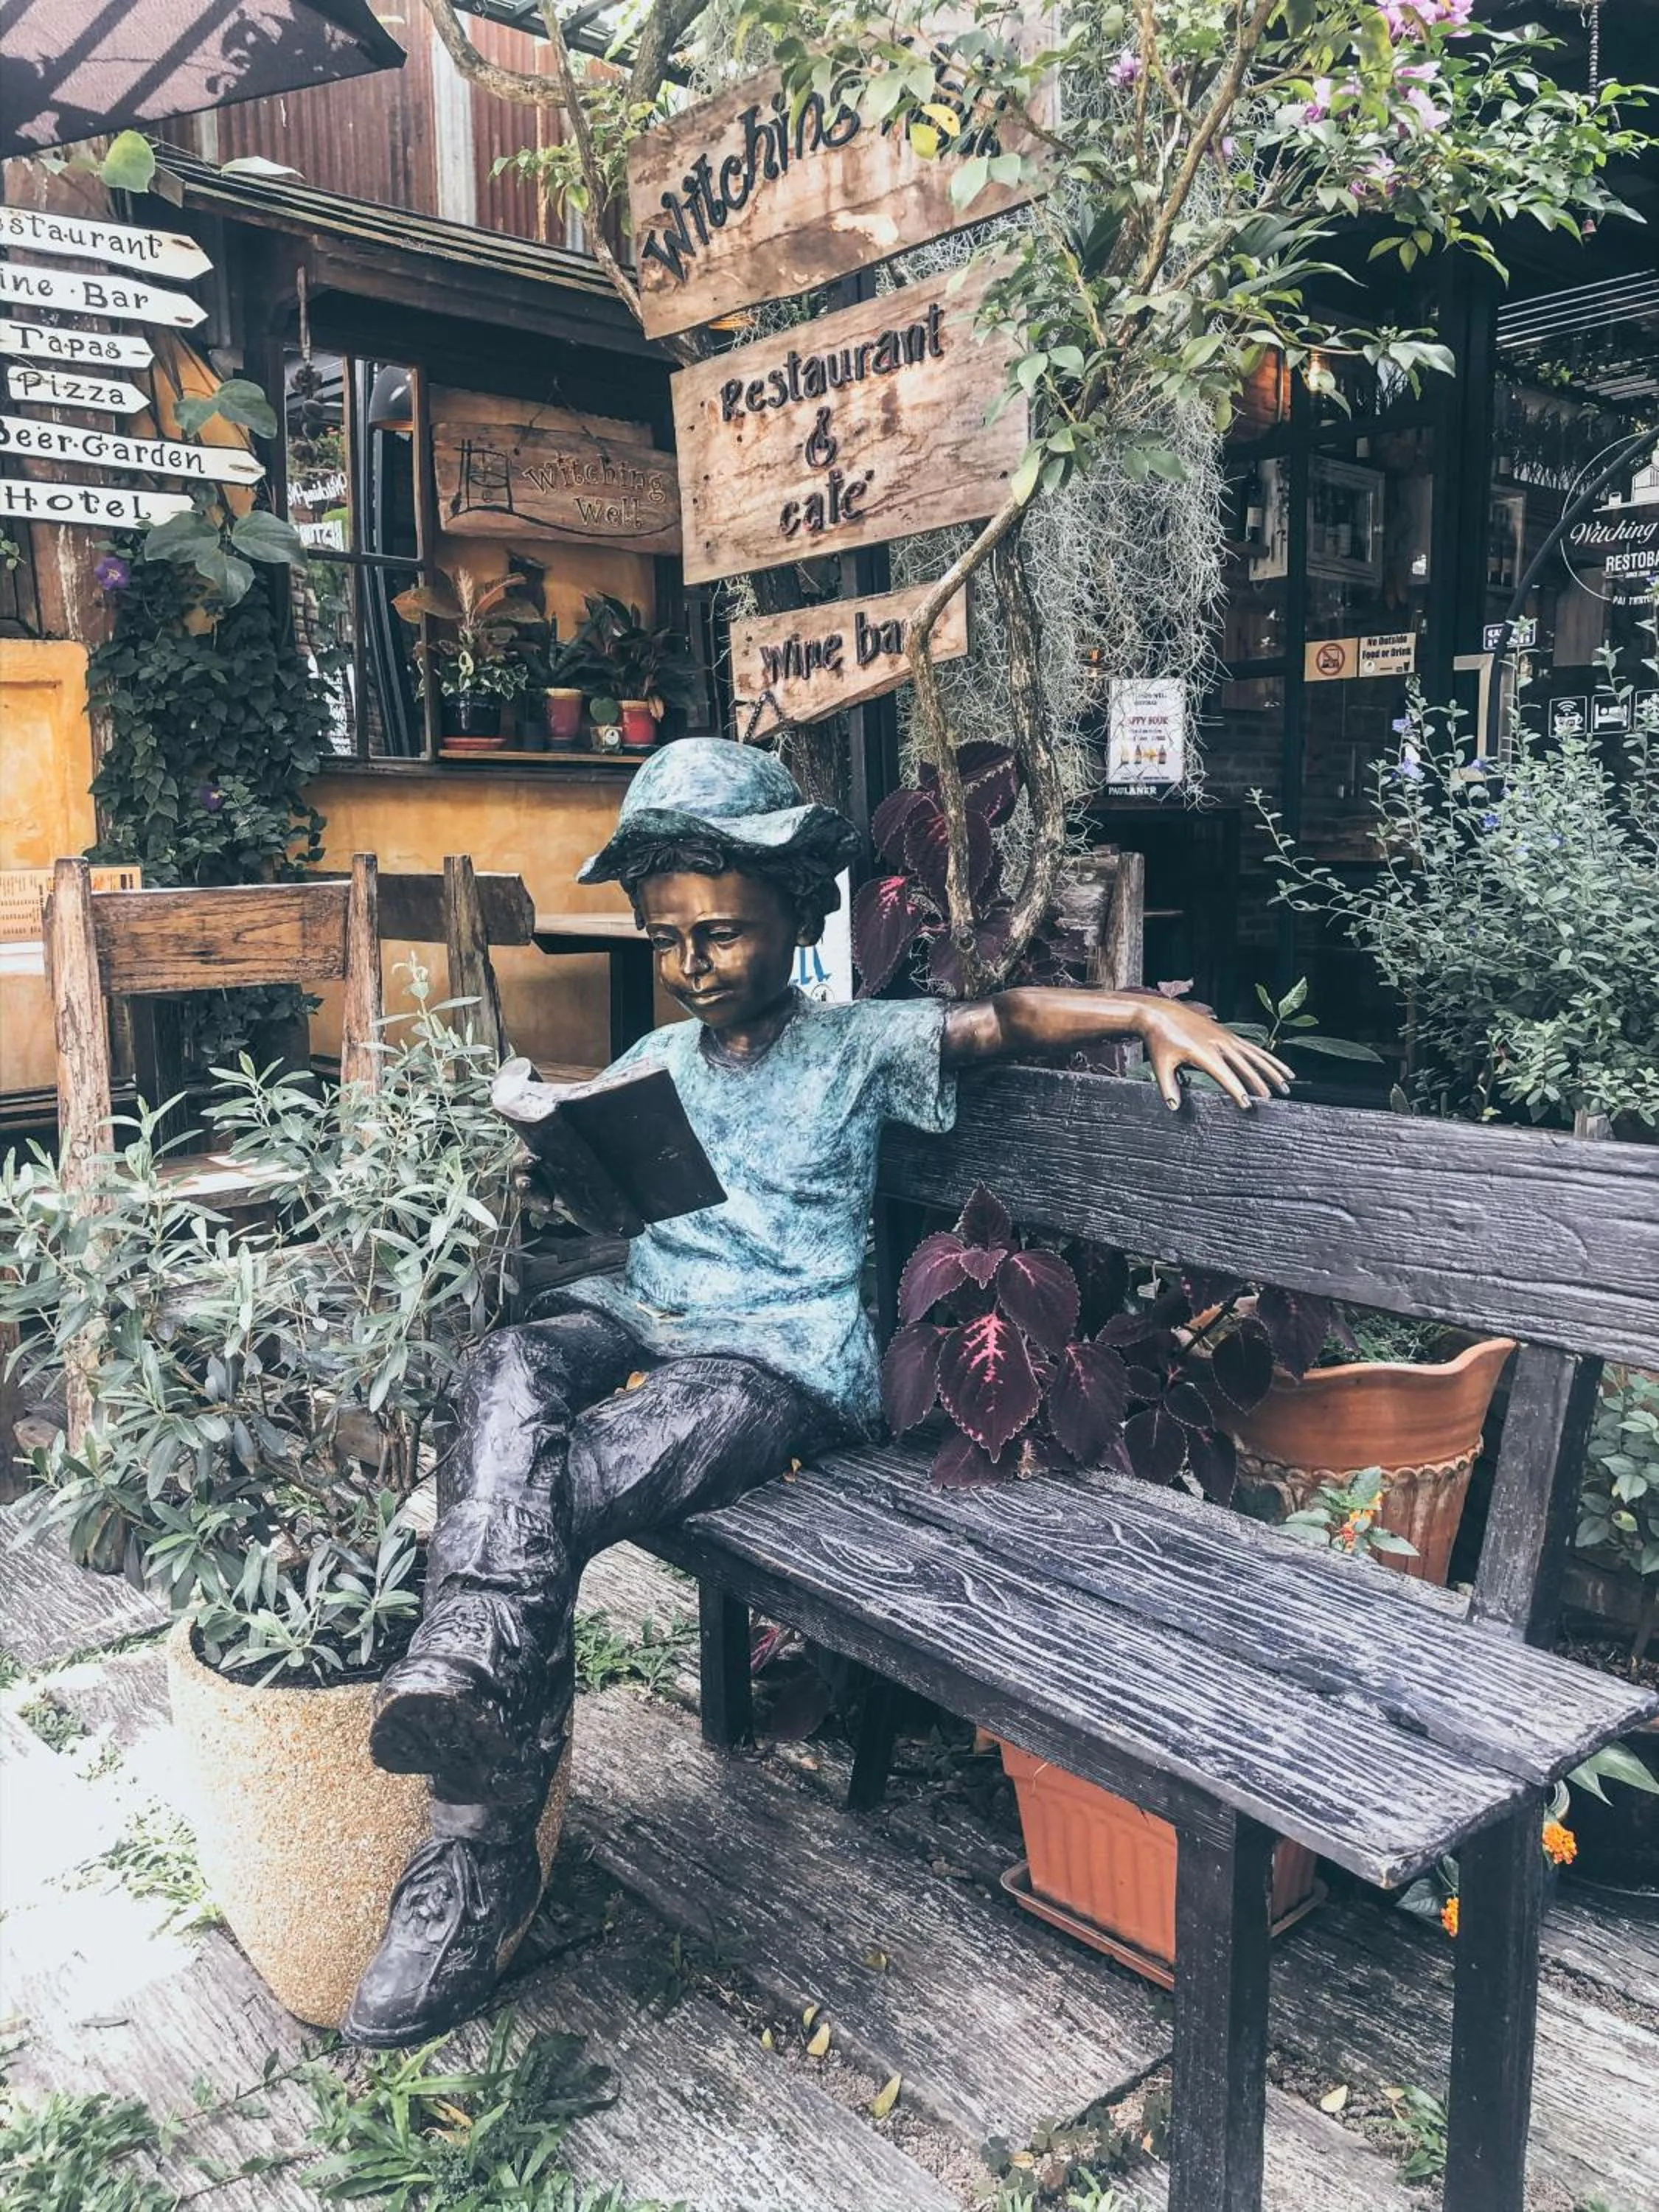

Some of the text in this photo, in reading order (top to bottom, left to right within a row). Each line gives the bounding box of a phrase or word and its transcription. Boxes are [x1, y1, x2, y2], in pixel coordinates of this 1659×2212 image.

[0, 213, 163, 260] staurant
[0, 268, 54, 297] ine
[10, 324, 122, 360] Tapas
[719, 302, 946, 422] Restaurant
[17, 371, 126, 406] Pizza
[522, 451, 667, 502] Witching
[573, 495, 643, 529] Well
[1570, 519, 1658, 546] Witching
[855, 611, 910, 664] ba
[1362, 647, 1411, 660] Food or Drink
[1367, 635, 1408, 647] No Outside
